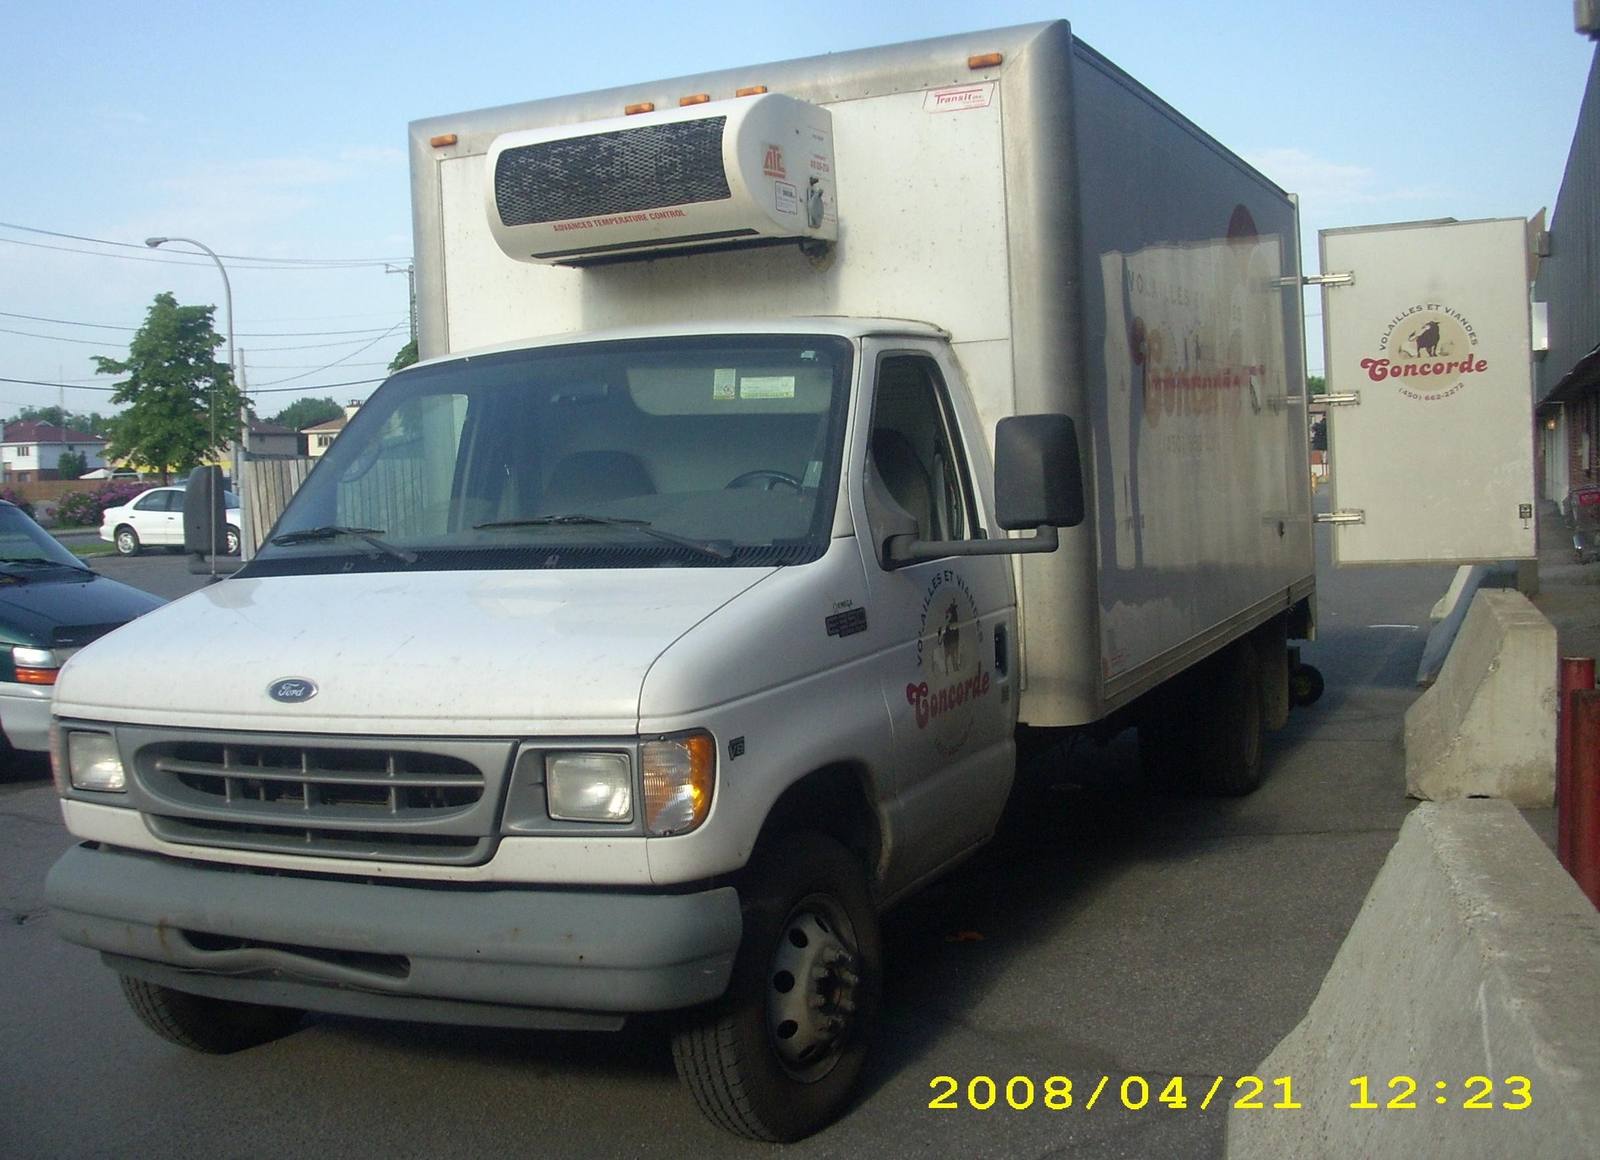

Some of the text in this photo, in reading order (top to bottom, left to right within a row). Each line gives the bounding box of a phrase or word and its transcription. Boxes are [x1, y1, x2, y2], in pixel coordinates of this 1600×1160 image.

[935, 88, 983, 104] Transit
[553, 209, 686, 232] ADVANCED TEMPERATURE CONTROL
[1379, 305, 1422, 350] VOLAILLES
[1444, 307, 1478, 346] VIANDES
[1360, 353, 1488, 381] Concorde
[1399, 388, 1422, 400] (450)
[916, 571, 943, 666] VOLAILLES
[944, 569, 954, 583] ET
[278, 682, 305, 697] Ford
[906, 660, 991, 730] Concorde
